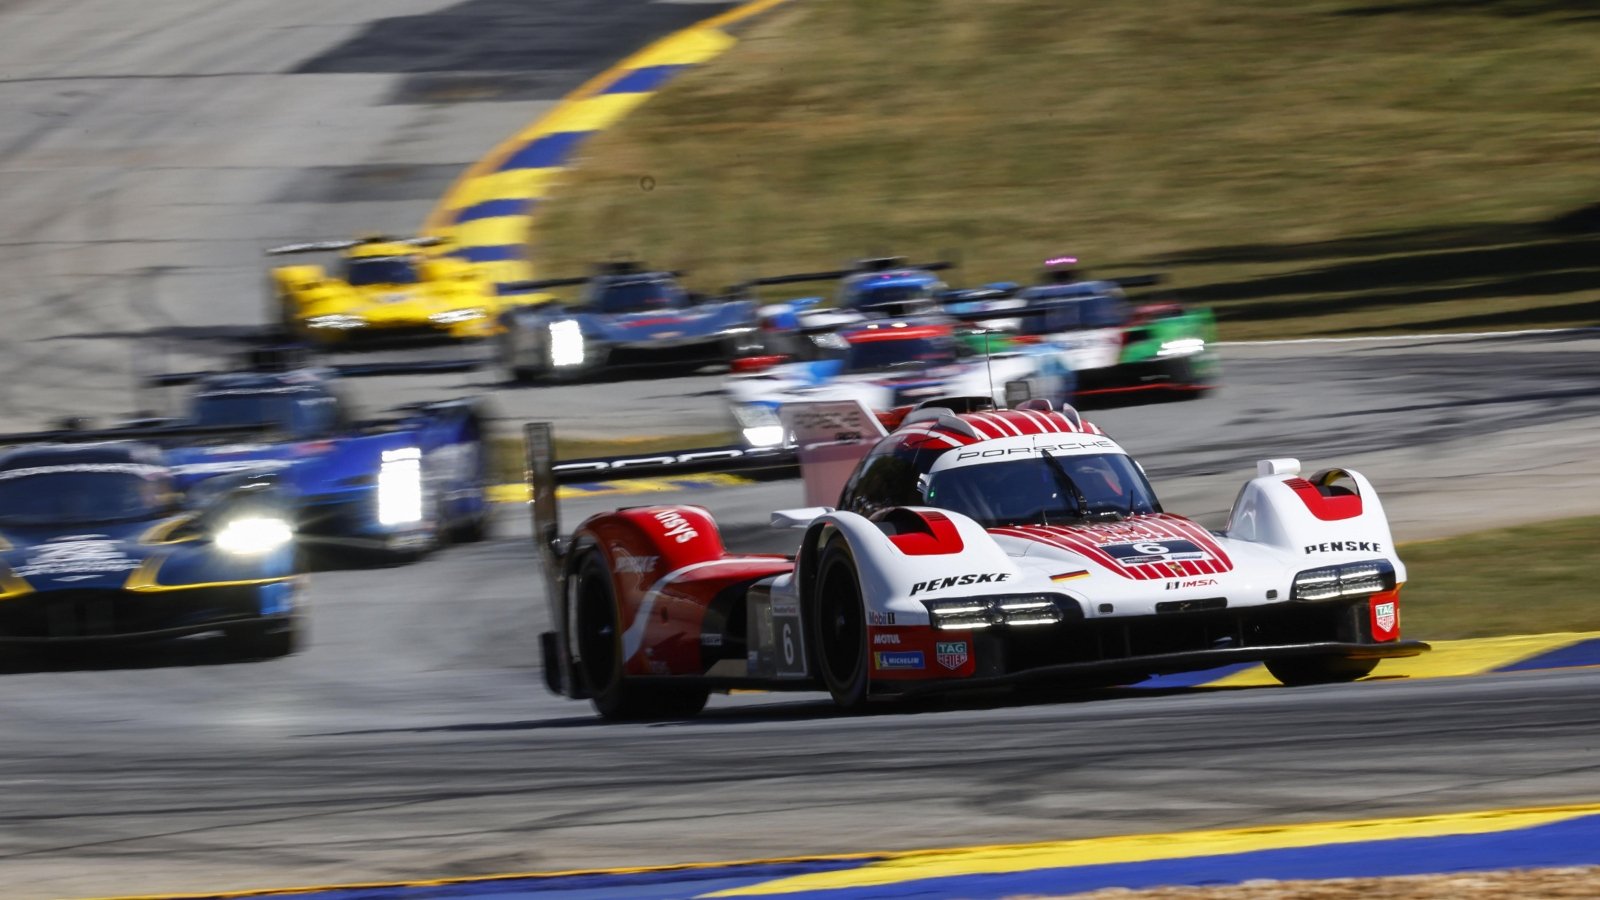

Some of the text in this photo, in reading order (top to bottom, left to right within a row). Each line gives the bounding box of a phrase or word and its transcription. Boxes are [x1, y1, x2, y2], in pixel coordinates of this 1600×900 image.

[957, 440, 1115, 462] PORSCHE
[1132, 542, 1170, 555] 6
[1304, 541, 1382, 555] PENSKE
[909, 573, 1012, 597] PENSKE
[1182, 579, 1218, 588] IMSA
[869, 612, 886, 625] Mobil
[782, 623, 794, 666] 6
[874, 634, 900, 645] MOTUL
[939, 643, 965, 653] TAG
[888, 656, 920, 665] MICHELIN
